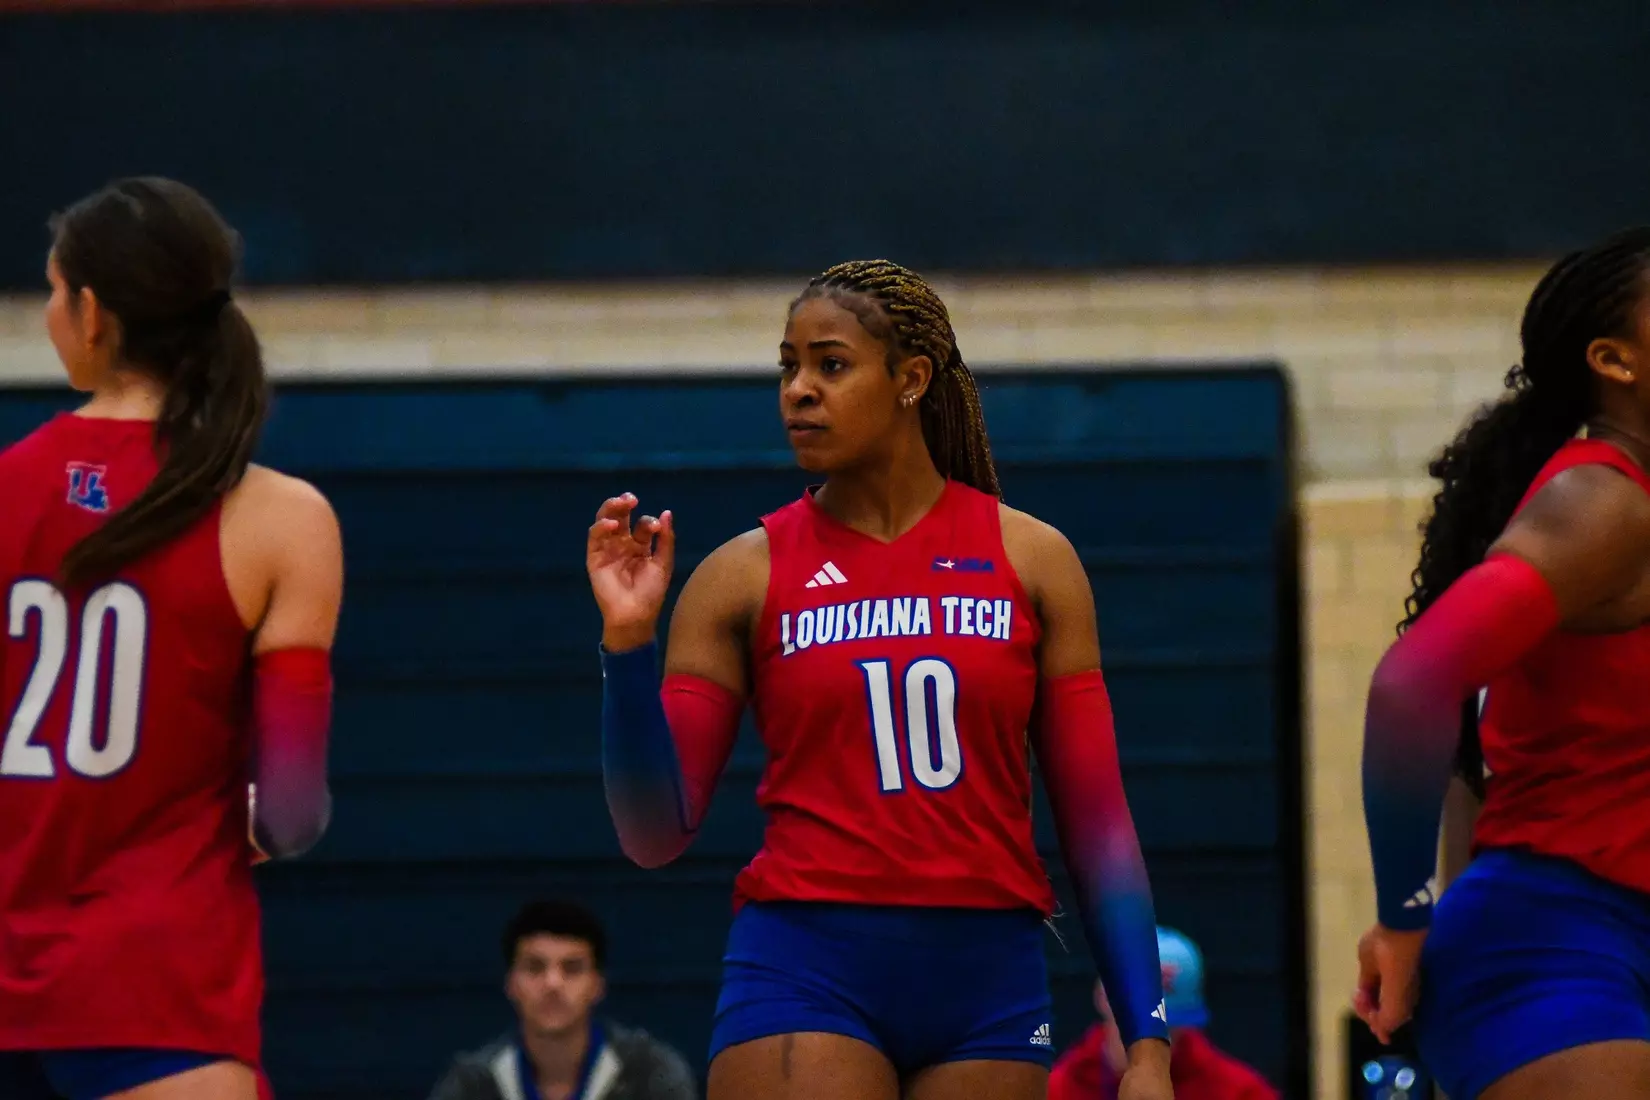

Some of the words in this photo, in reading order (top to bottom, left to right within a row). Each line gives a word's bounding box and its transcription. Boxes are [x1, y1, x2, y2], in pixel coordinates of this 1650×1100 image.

[0, 577, 147, 778] 20
[780, 596, 932, 657] LOUISIANA
[940, 595, 1013, 641] TECH
[855, 657, 963, 792] 10
